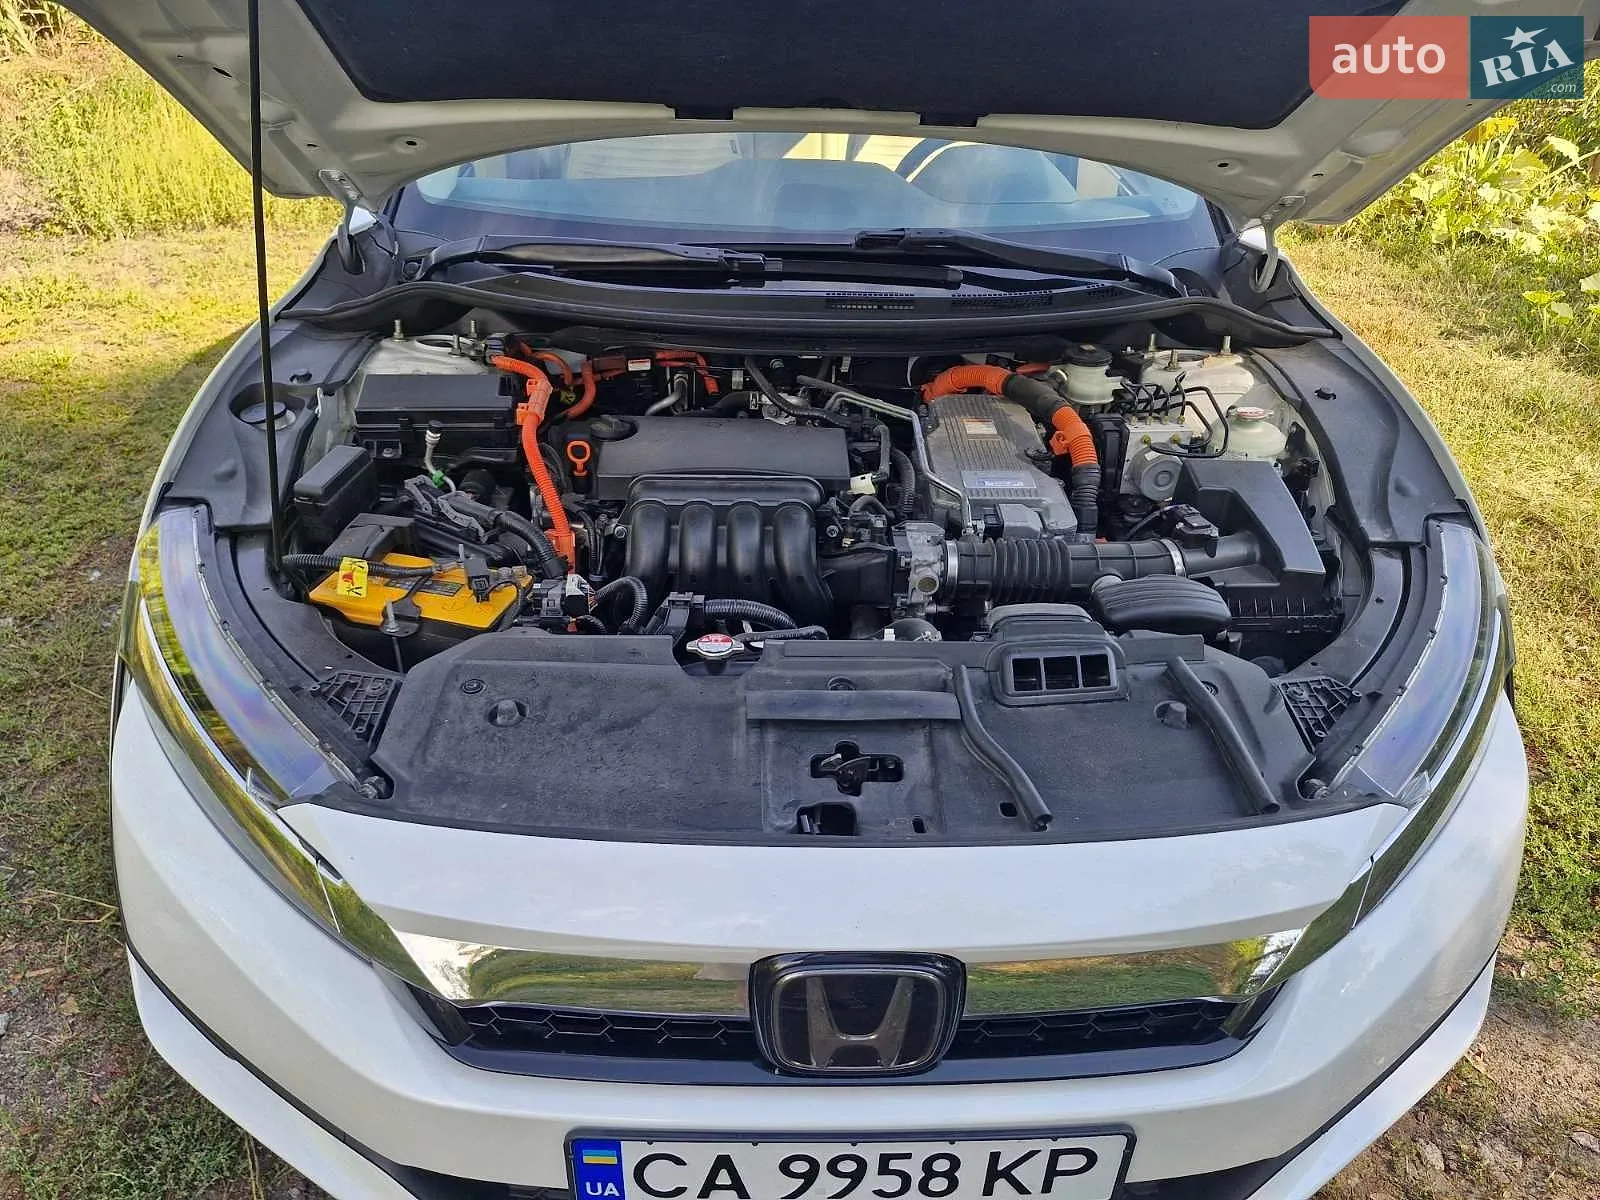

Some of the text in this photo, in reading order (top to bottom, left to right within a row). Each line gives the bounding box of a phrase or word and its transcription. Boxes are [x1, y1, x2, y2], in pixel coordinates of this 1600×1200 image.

[585, 1181, 620, 1197] UA
[633, 1147, 1098, 1199] CA 9958 KP
